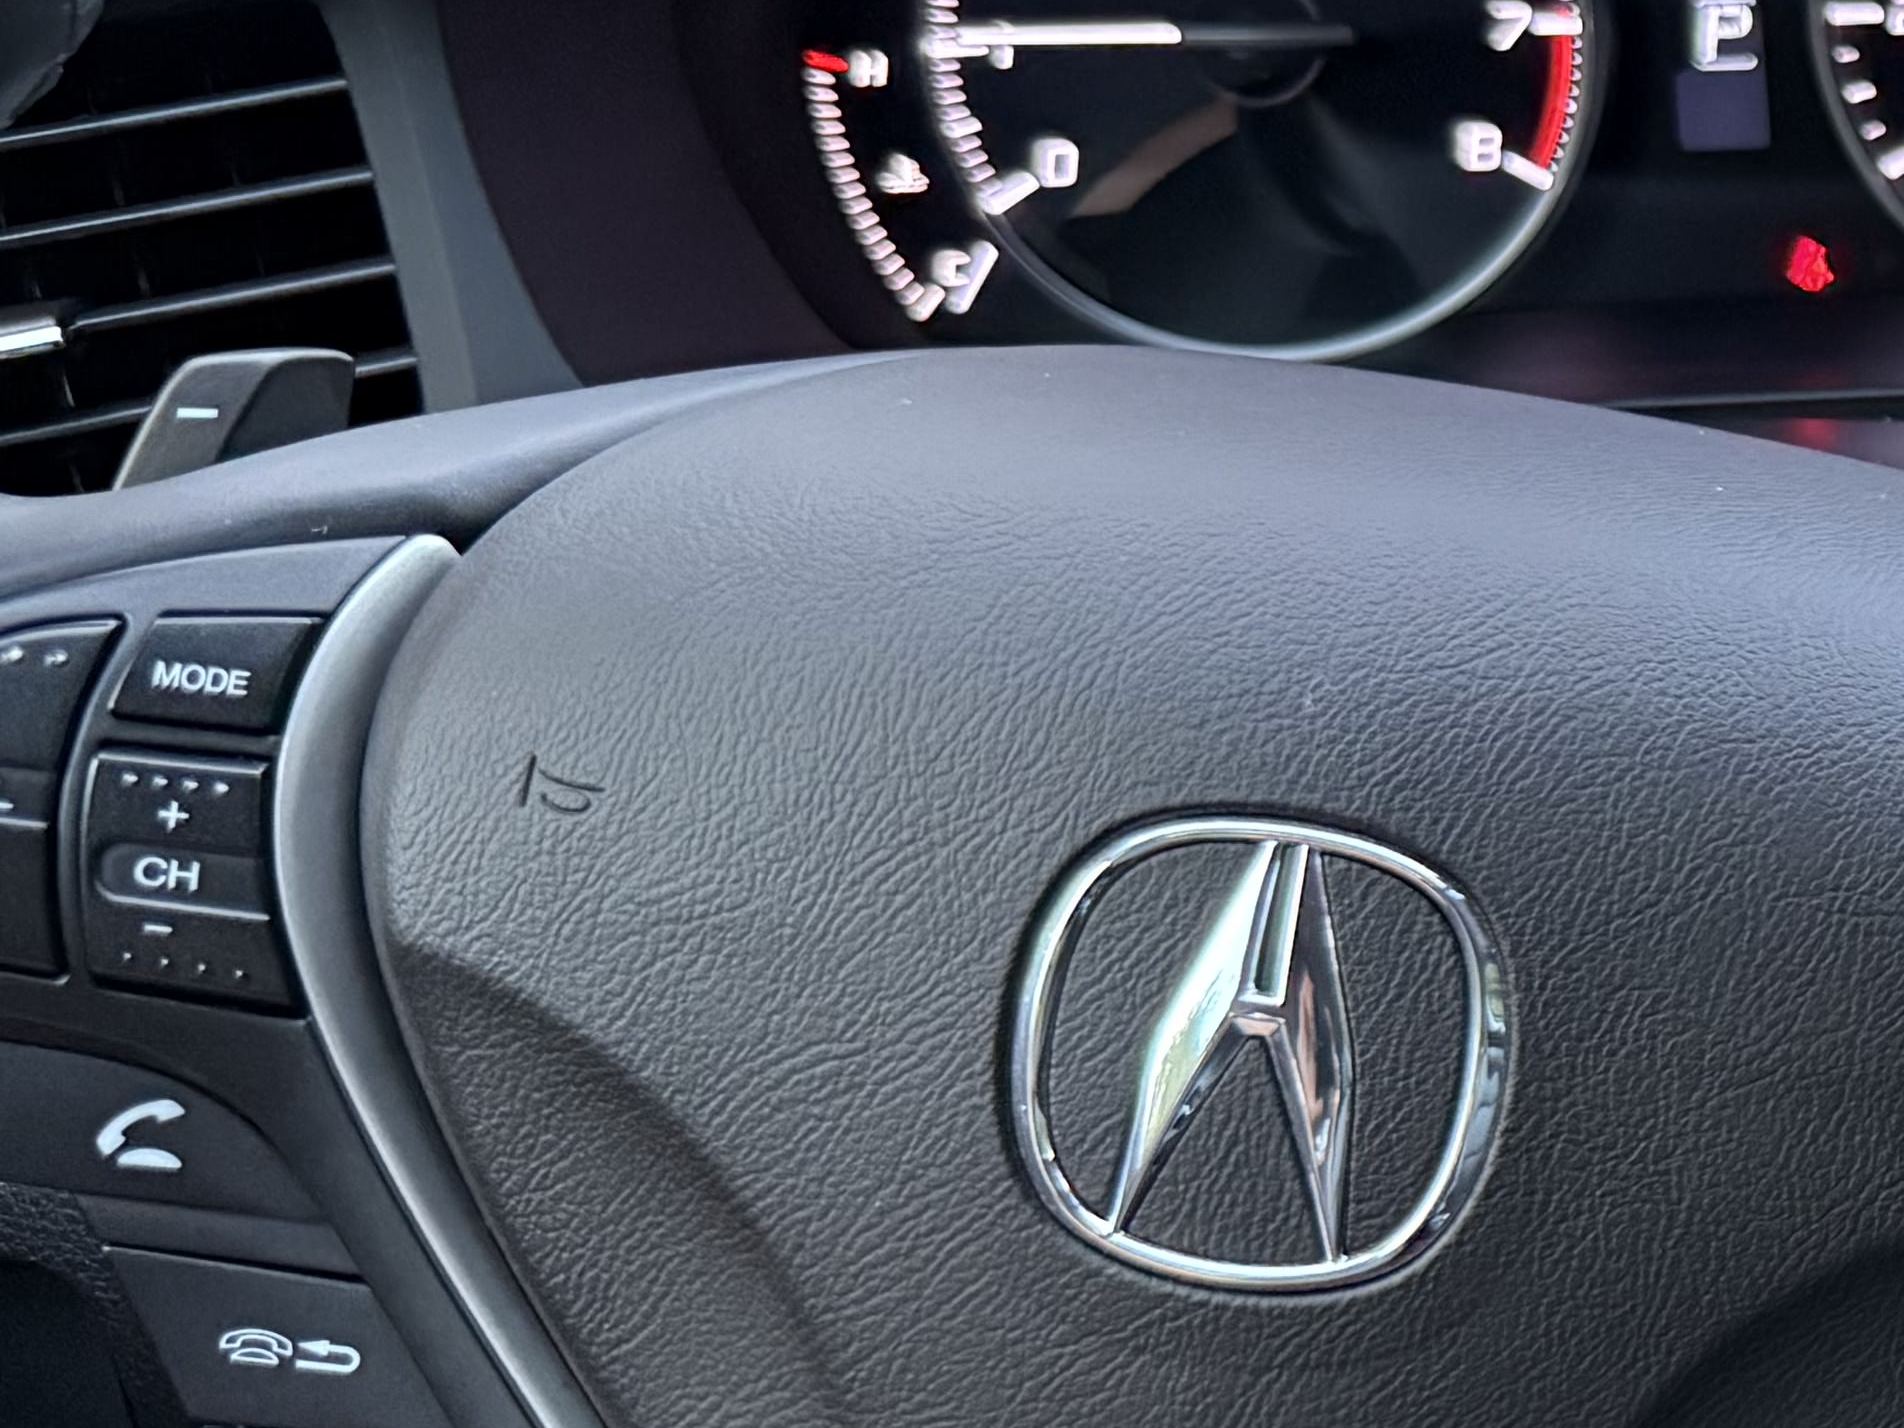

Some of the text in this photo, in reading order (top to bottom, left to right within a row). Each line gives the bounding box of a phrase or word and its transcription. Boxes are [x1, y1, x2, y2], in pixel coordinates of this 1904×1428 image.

[1692, 0, 1755, 68] P
[845, 48, 889, 89] H
[1030, 136, 1080, 189] 0
[1453, 119, 1504, 173] 8
[150, 659, 252, 698] MODE
[132, 856, 203, 894] CH
